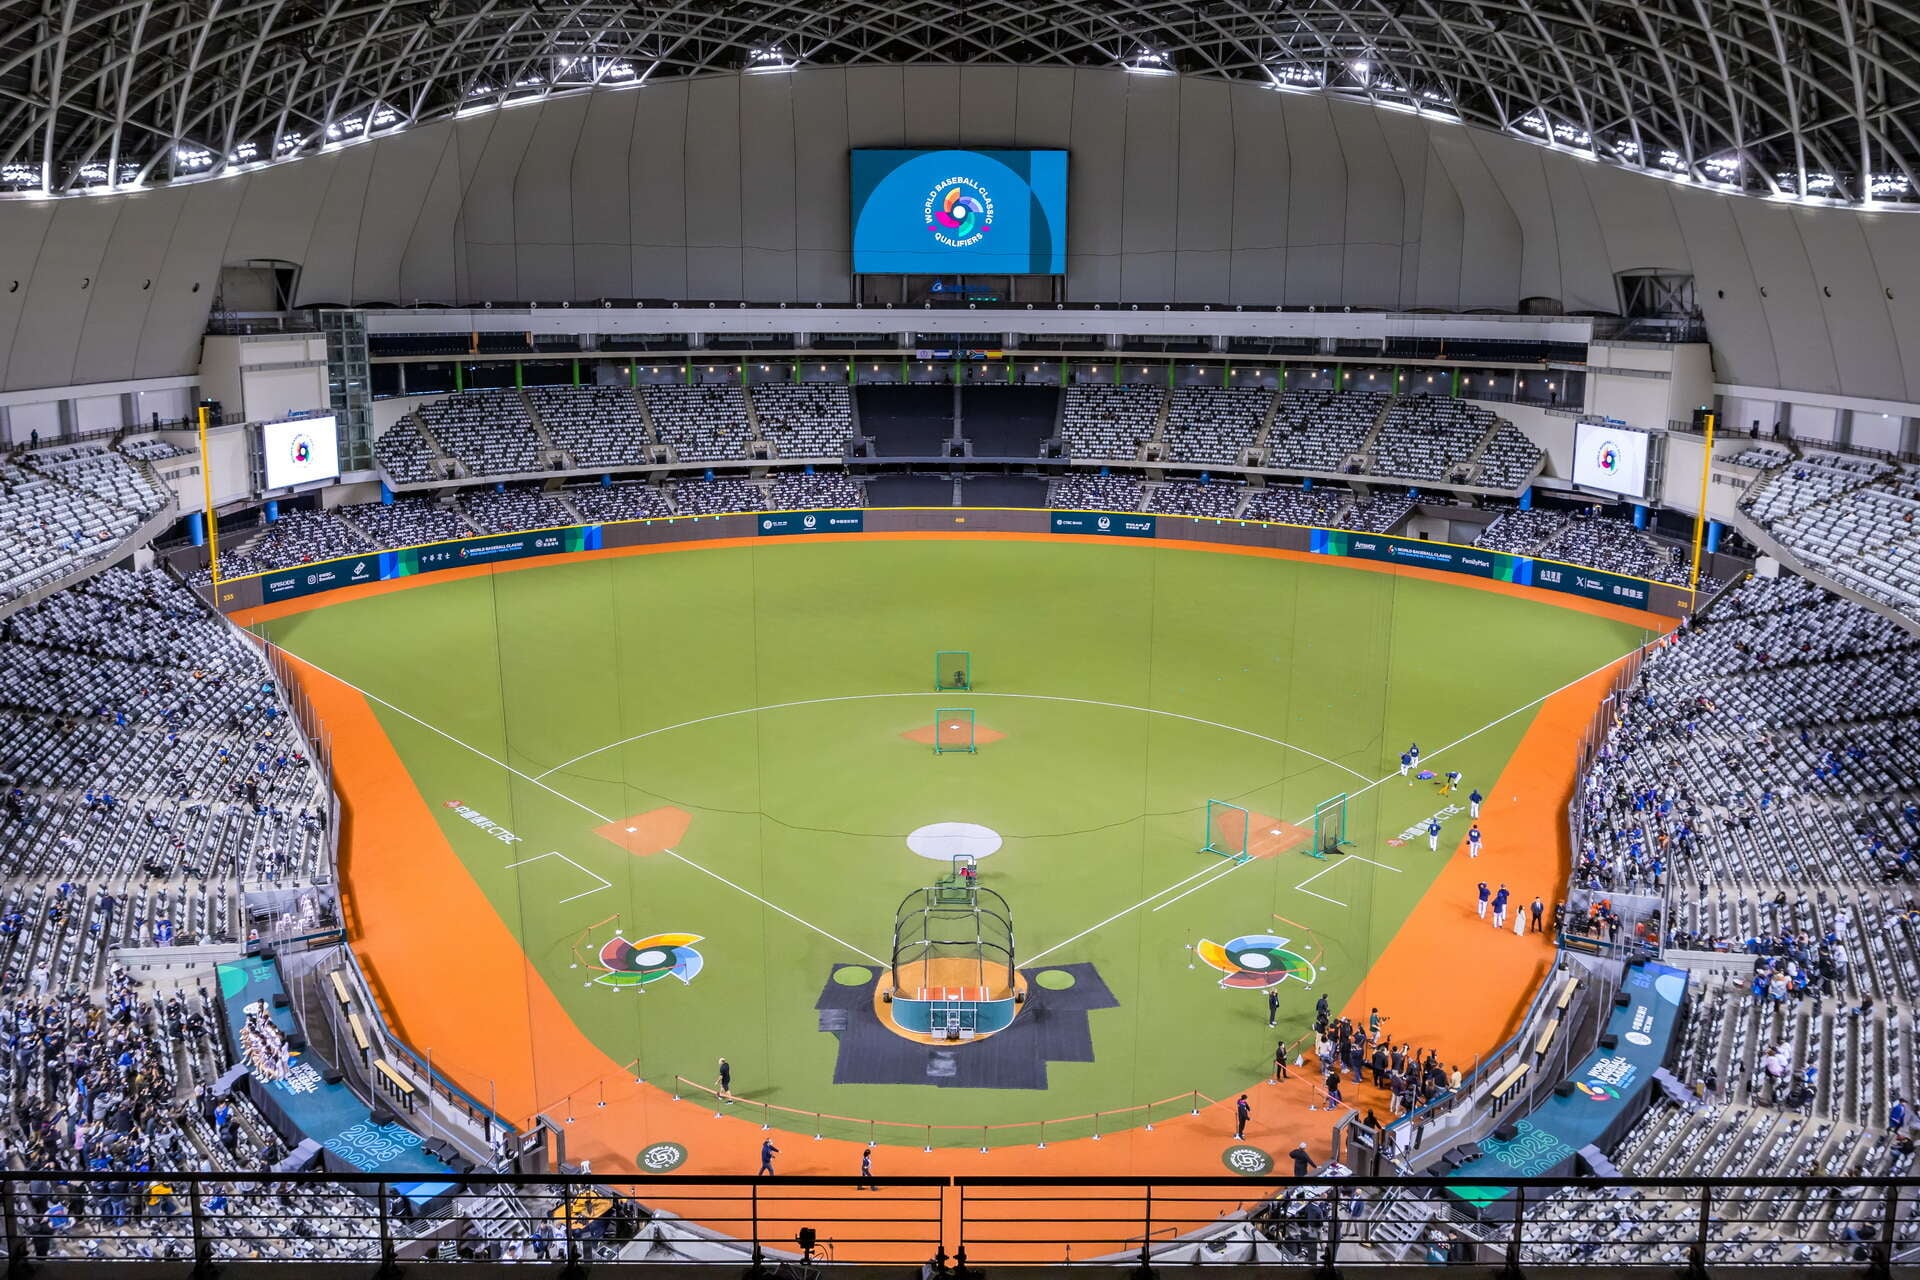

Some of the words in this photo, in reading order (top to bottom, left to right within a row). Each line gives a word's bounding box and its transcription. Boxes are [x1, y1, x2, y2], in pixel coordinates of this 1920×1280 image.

[925, 190, 937, 224] WORLD
[935, 177, 979, 192] BASEBALL
[978, 187, 993, 225] CLASSIC
[935, 232, 983, 247] QUALIFIERS
[470, 546, 485, 554] WORLD
[485, 544, 505, 552] BASEBALL
[506, 541, 524, 549] CLASSIC
[1355, 541, 1376, 550] Amway
[1412, 549, 1432, 557] BASEBALL
[1433, 552, 1452, 560] CLASSIC
[1462, 556, 1490, 568] FamilyMart
[488, 826, 523, 845] CTBC
[300, 1062, 322, 1082] WORLD
[1587, 1057, 1611, 1077] WORLD
[1597, 1055, 1626, 1082] BASEBALL
[1607, 1062, 1633, 1085] CLASSIC
[291, 1066, 319, 1094] BASEBALL
[339, 1124, 405, 1162] 2025
[1496, 1129, 1559, 1169] 2025
